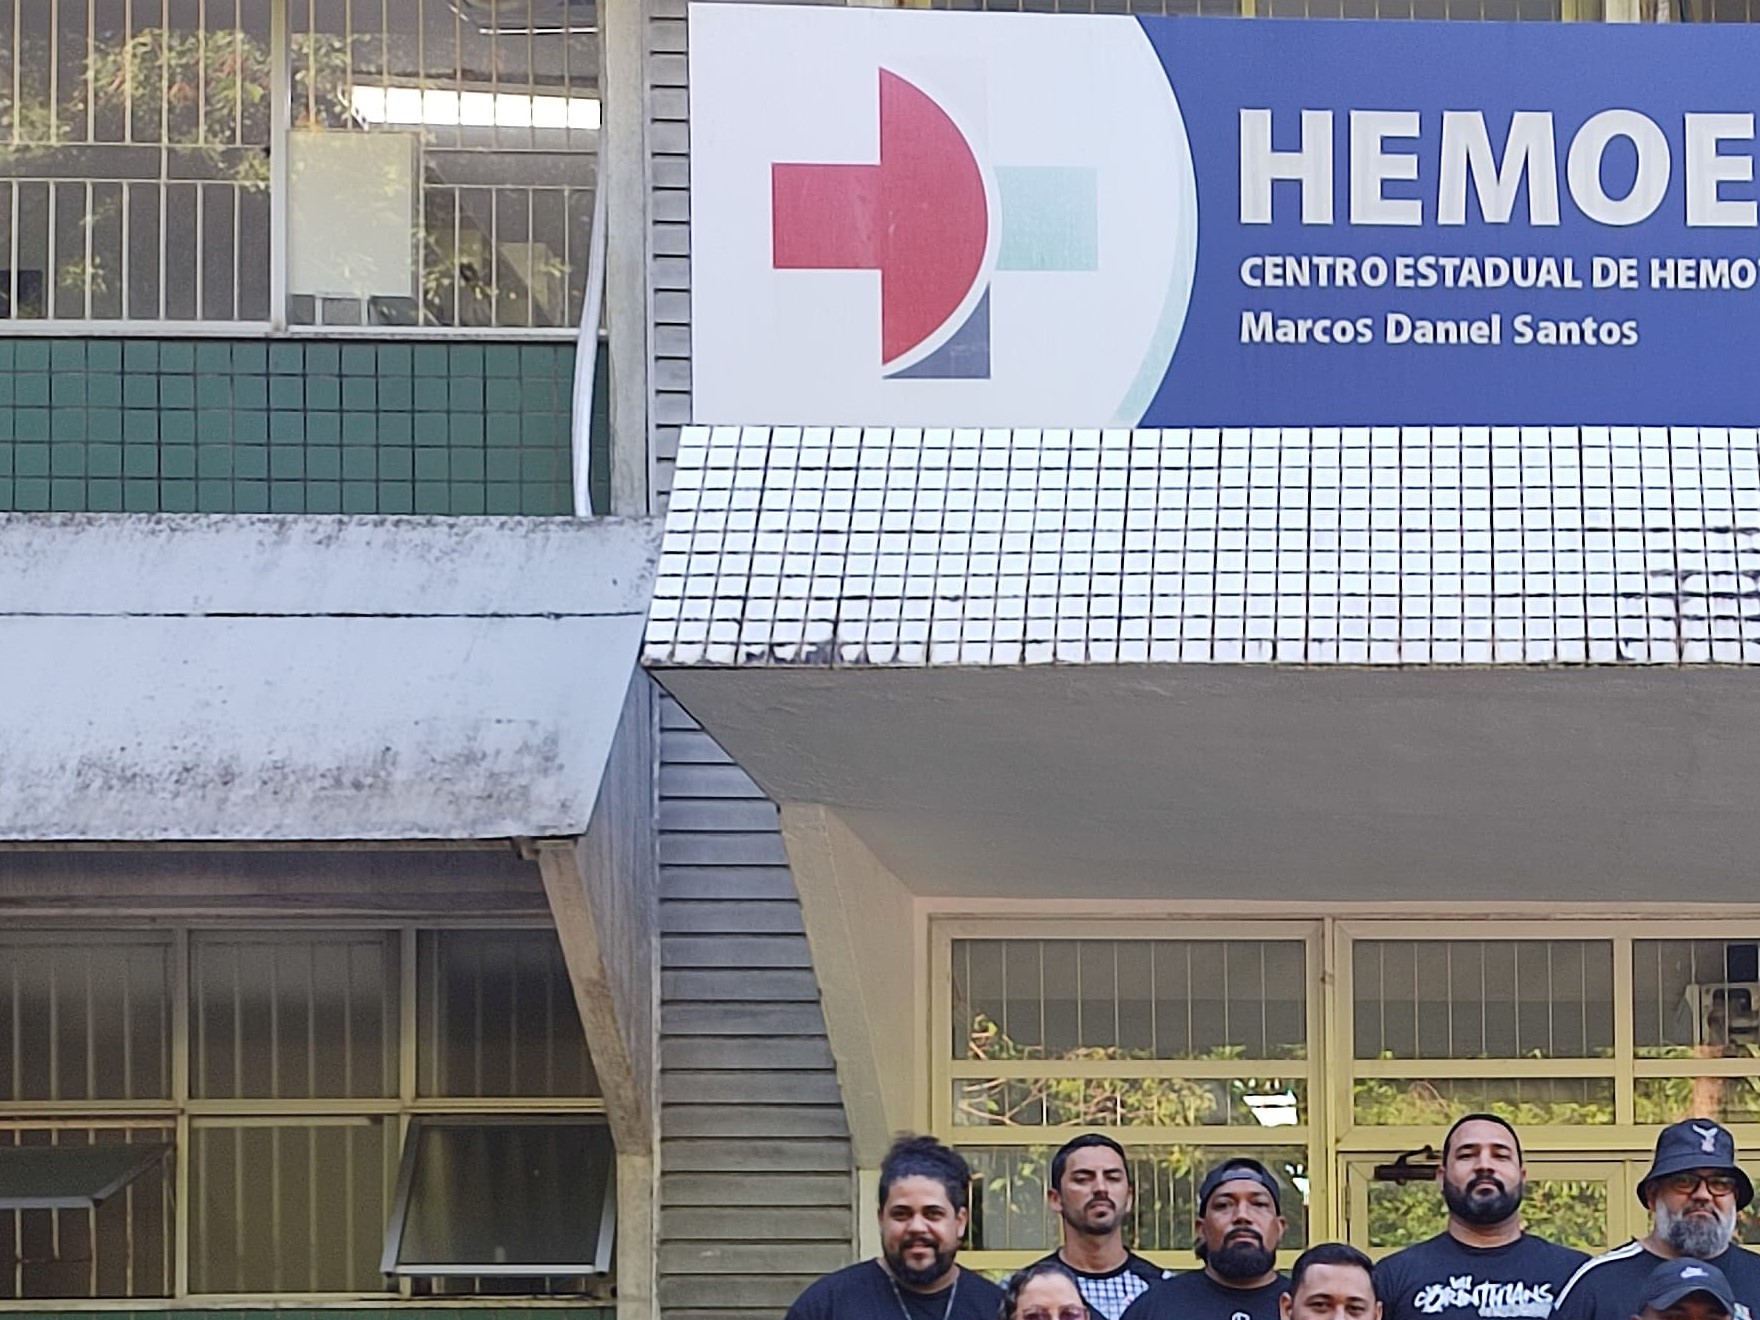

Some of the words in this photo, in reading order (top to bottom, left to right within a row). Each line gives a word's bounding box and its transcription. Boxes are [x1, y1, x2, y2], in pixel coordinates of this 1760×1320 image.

[1240, 255, 1388, 287] CENTRO
[1395, 255, 1583, 289] ESTADUAL
[1592, 256, 1639, 289] DE
[1240, 311, 1373, 344] Marcos
[1513, 314, 1638, 345] Santos
[1412, 1279, 1555, 1314] CORINTHIANS
